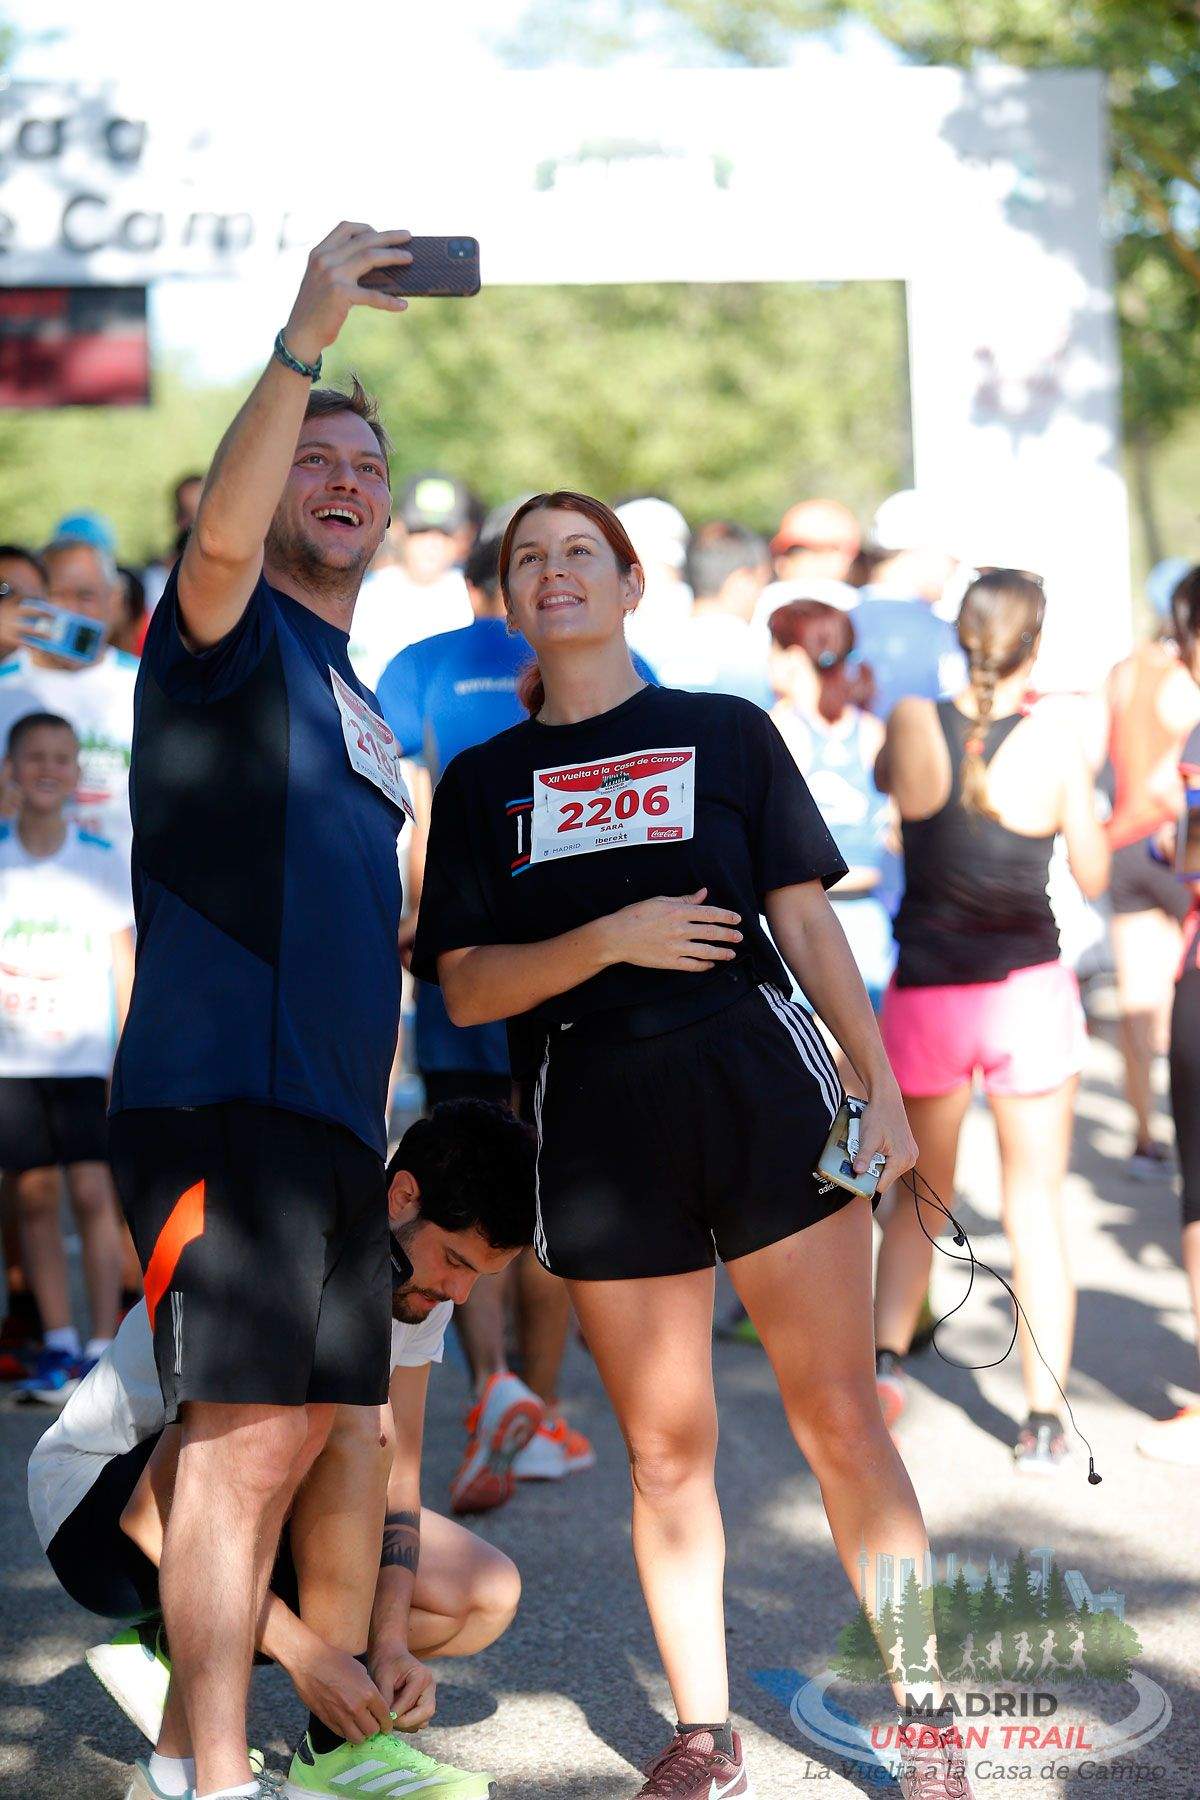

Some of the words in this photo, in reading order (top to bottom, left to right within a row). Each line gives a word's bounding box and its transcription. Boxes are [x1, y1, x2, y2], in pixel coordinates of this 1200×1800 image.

[548, 776, 560, 784] XII
[562, 770, 591, 781] Vuelta
[601, 766, 610, 774] la
[614, 760, 635, 772] Casa
[557, 785, 670, 833] 2206
[600, 822, 624, 832] SARA
[595, 833, 628, 845] Iberext
[552, 842, 581, 854] MADRID
